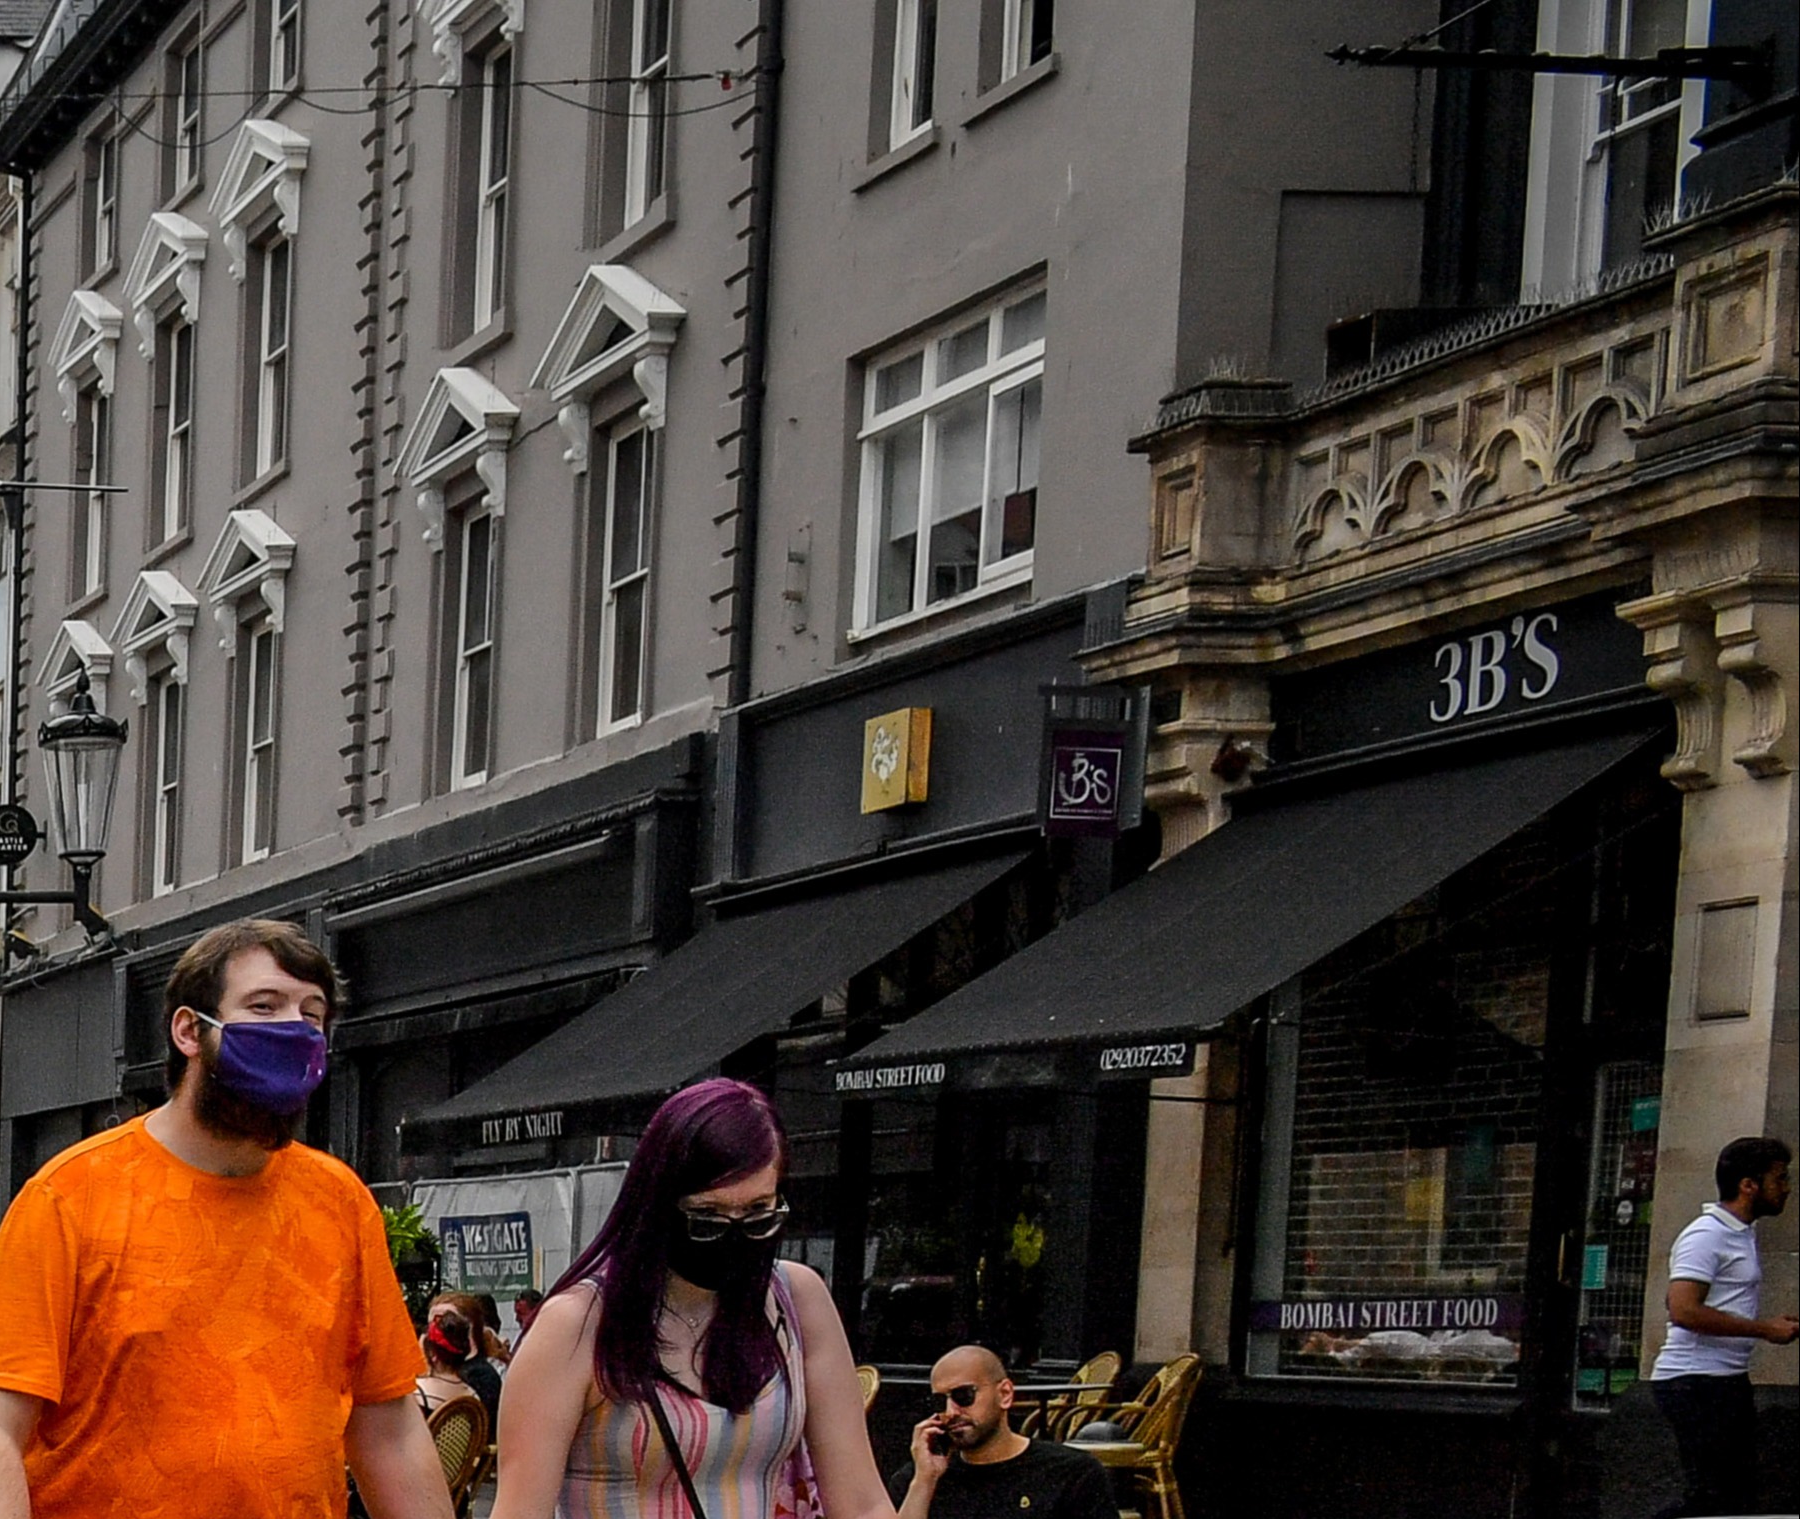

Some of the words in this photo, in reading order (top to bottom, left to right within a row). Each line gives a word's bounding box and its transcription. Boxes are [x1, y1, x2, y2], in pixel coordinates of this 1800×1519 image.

[1100, 1043, 1186, 1071] 02920372352
[875, 1065, 915, 1088] STREET
[915, 1063, 946, 1085] FOOD
[482, 1119, 502, 1144] FLY
[505, 1116, 521, 1142] BY
[525, 1111, 564, 1138] NIGHT
[1280, 1302, 1354, 1330] BOMBAI
[1359, 1300, 1437, 1329] STREET
[1441, 1298, 1498, 1327] FOOD
